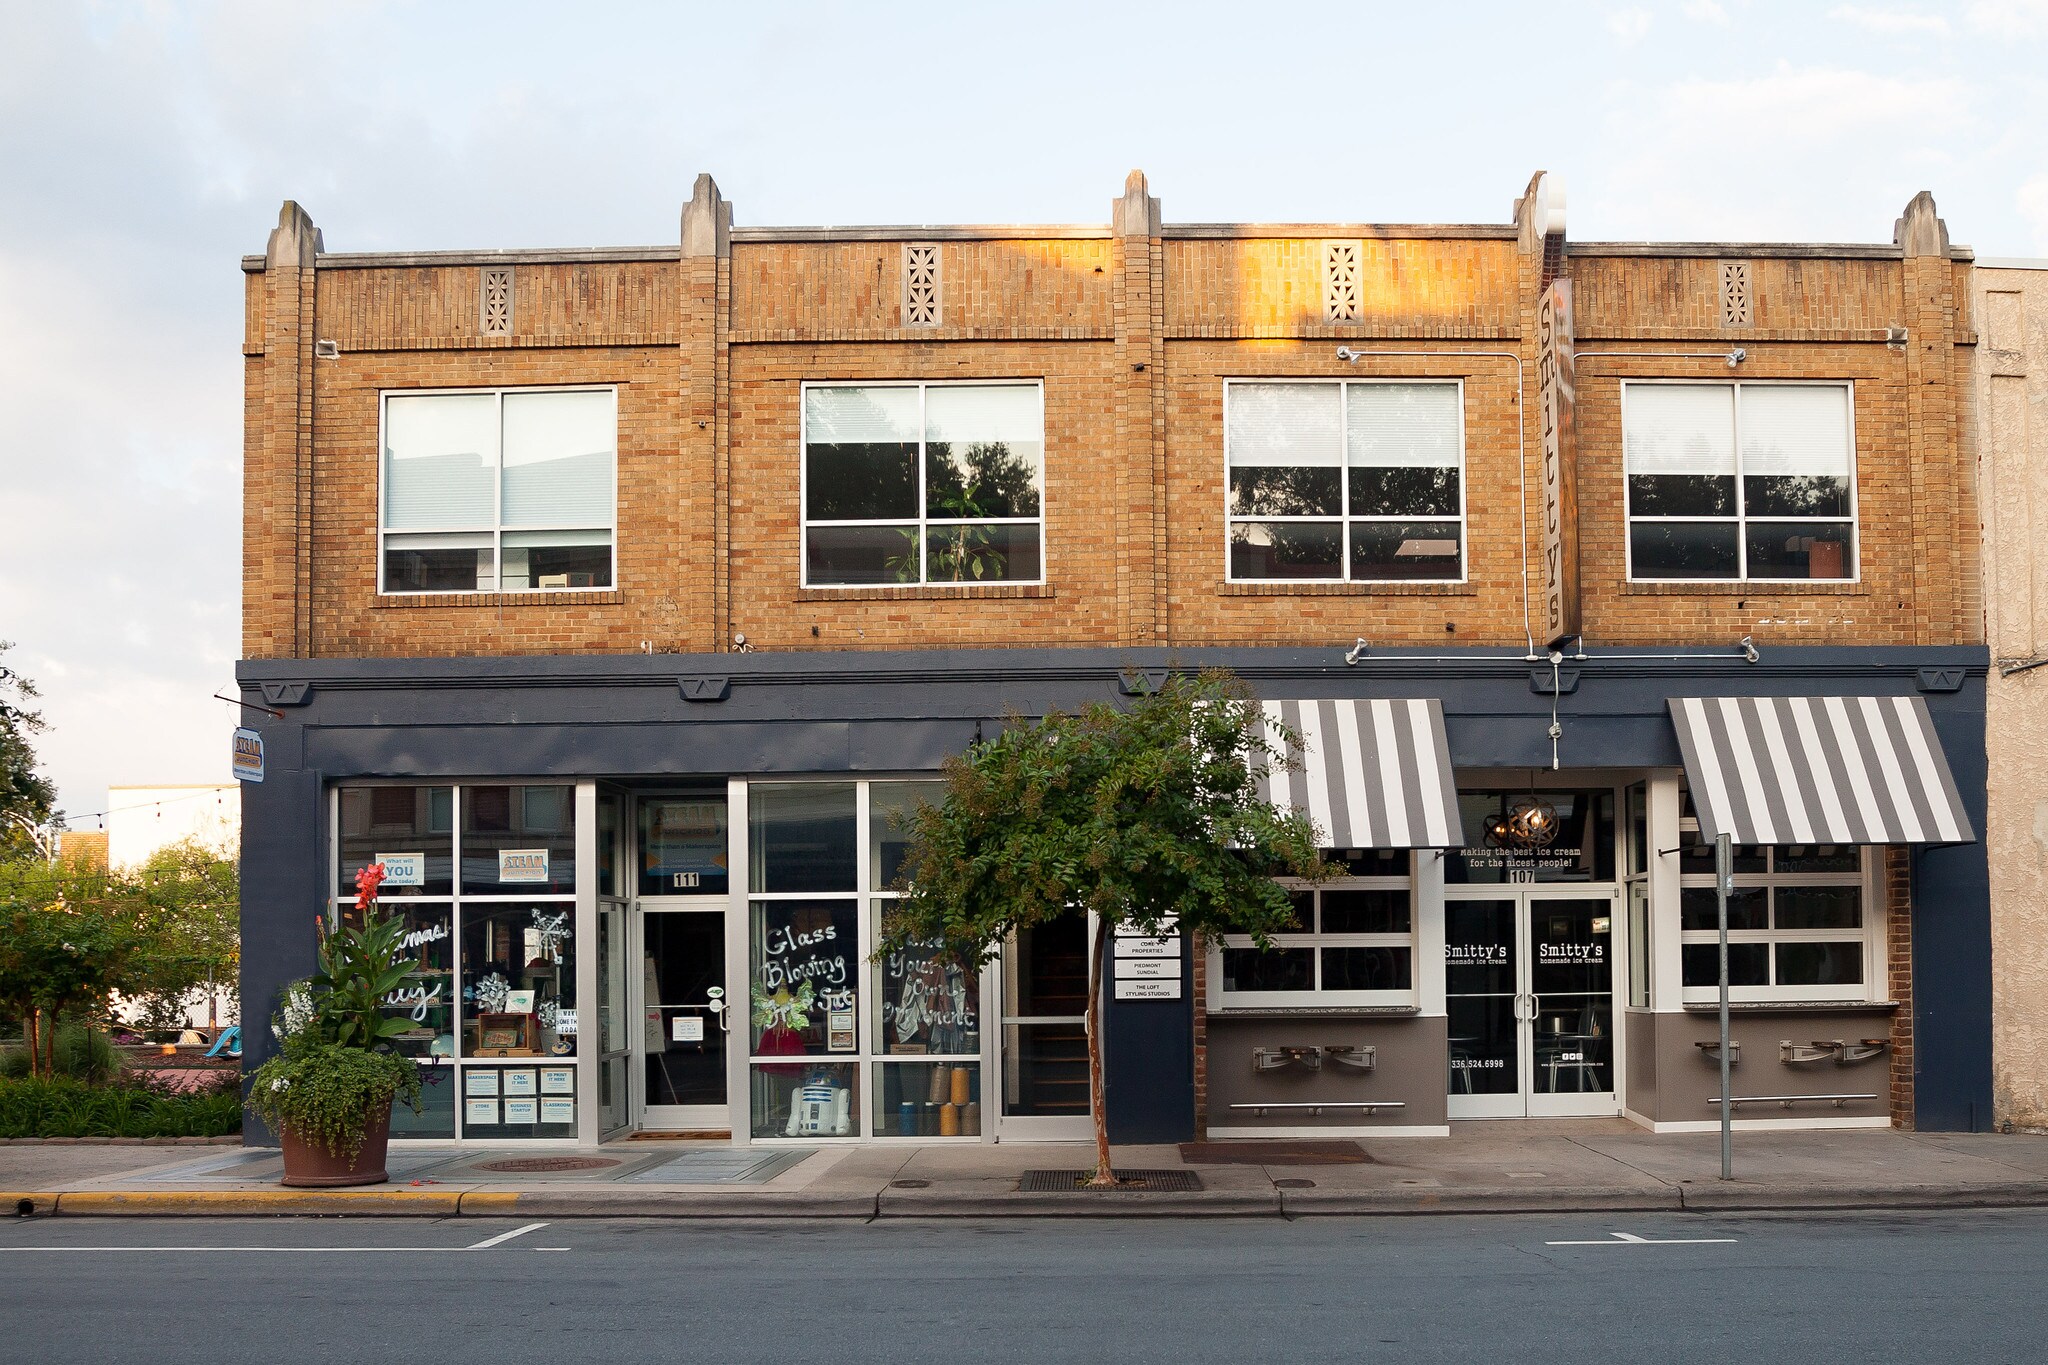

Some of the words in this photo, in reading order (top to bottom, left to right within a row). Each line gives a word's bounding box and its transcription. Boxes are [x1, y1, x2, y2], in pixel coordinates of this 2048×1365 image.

[235, 736, 260, 755] STEAM
[1460, 848, 1491, 856] Making
[504, 855, 544, 868] STEAM
[1470, 859, 1485, 867] for
[1488, 859, 1503, 867] the
[1506, 859, 1536, 867] nicest
[1539, 858, 1572, 868] people!
[386, 866, 414, 876] YOU
[1511, 870, 1534, 883] 107
[676, 874, 698, 886] 111
[765, 925, 837, 955] Glass
[1445, 944, 1506, 958] Smitty's
[1540, 943, 1603, 958] Smitty's
[764, 954, 846, 989] Blowing
[882, 1002, 975, 1026] Oment
[1451, 1060, 1504, 1068] 336.524.6998
